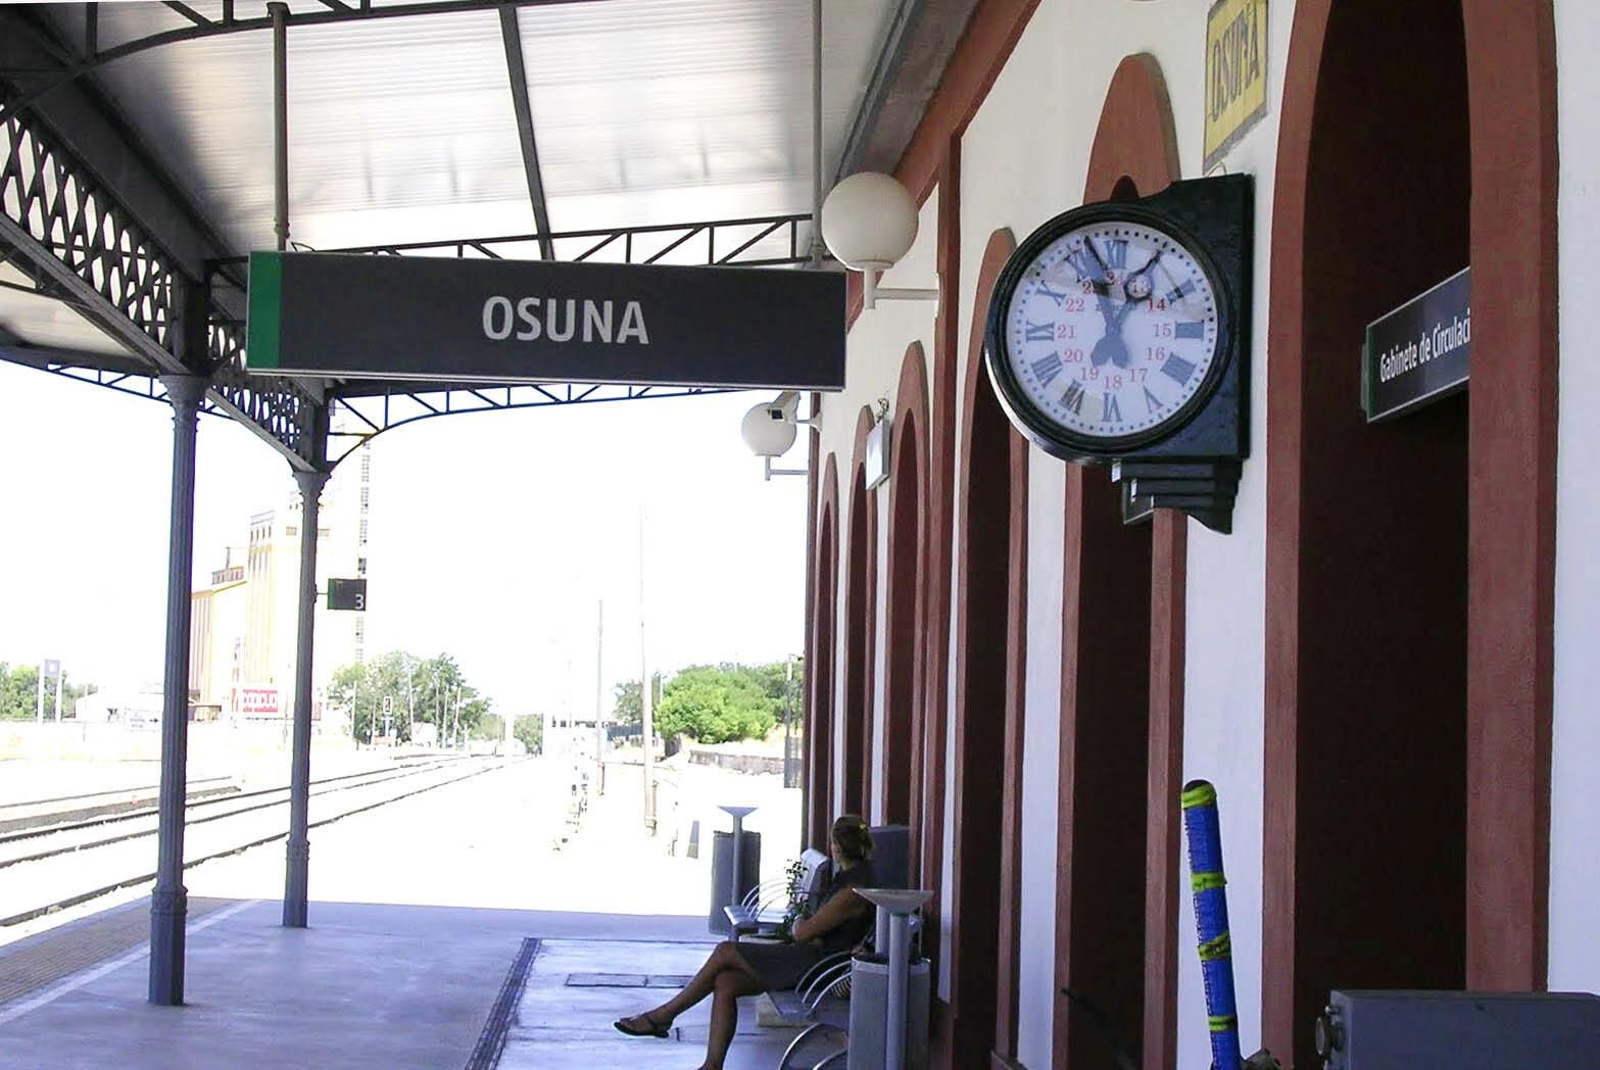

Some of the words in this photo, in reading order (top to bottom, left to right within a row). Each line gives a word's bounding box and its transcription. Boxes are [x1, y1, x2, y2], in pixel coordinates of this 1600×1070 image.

[1212, 1, 1260, 122] OSUNA
[1066, 299, 1085, 312] 22
[1148, 296, 1167, 310] 14
[482, 295, 649, 344] OSUNA
[1057, 325, 1076, 338] 21
[1152, 324, 1172, 337] 15
[1064, 349, 1083, 363] 20
[1146, 347, 1165, 361] 16
[1380, 341, 1417, 382] Gabinete
[1419, 332, 1430, 364] de
[1081, 367, 1099, 380] 19
[1129, 368, 1148, 382] 17
[1104, 375, 1123, 389] 18
[355, 594, 364, 609] 3
